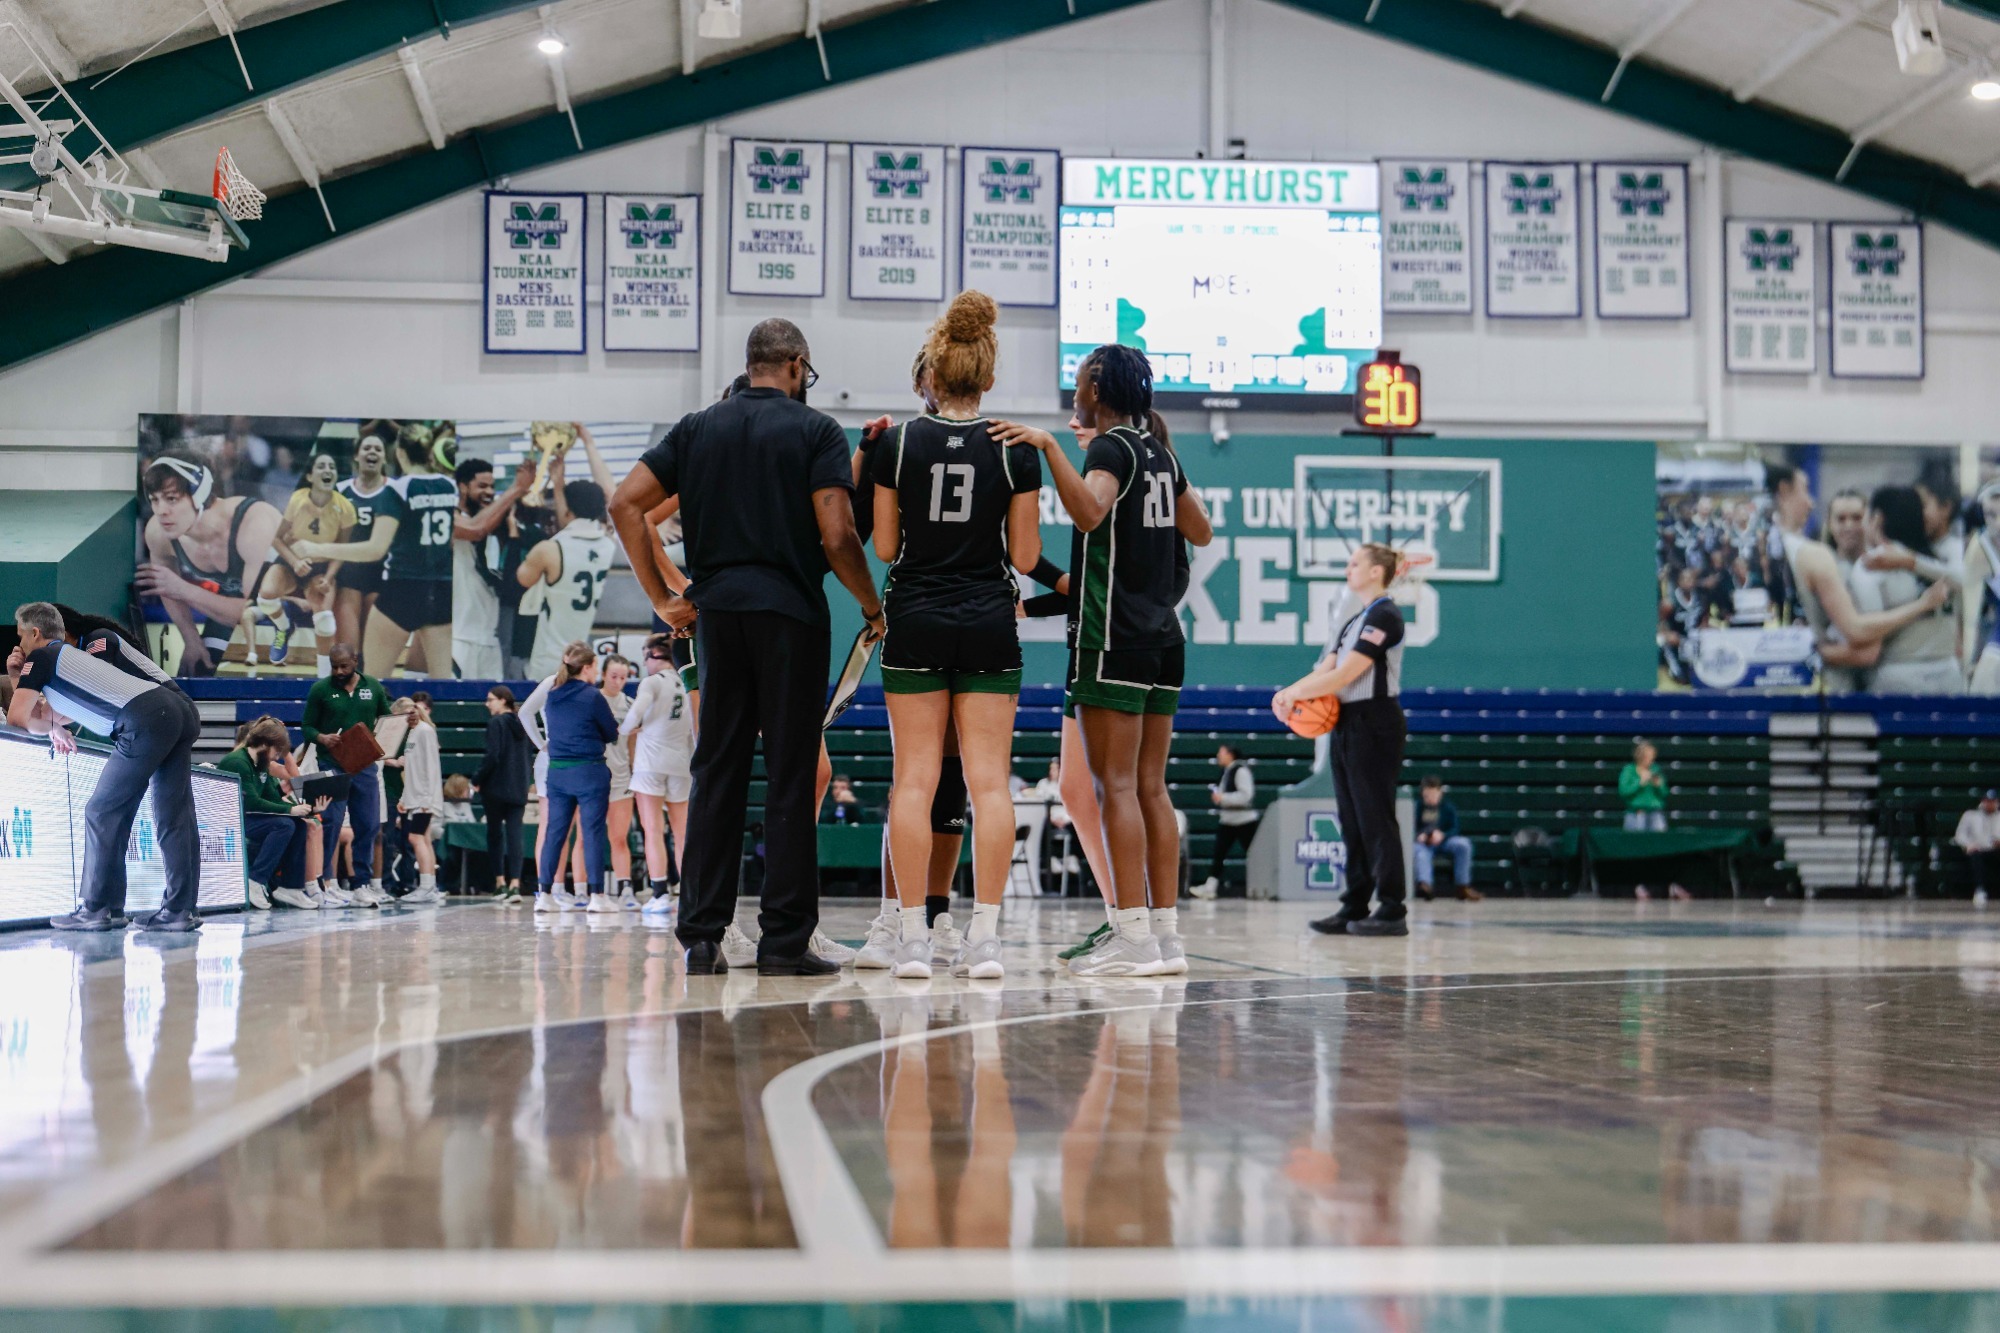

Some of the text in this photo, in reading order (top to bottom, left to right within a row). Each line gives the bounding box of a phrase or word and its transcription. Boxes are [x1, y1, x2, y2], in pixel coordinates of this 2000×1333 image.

[1094, 165, 1348, 203] MERCYHURST
[745, 202, 810, 220] ELITE 8
[866, 207, 930, 225] ELITE 8
[973, 212, 1046, 229] NATIONAL
[1389, 222, 1460, 236] NATIONAL
[965, 229, 1052, 246] CHAMPIONS
[1387, 238, 1463, 254] CHAMPION
[1491, 233, 1571, 245] TOURNAMENT
[739, 241, 815, 255] BASKETBALL
[859, 245, 935, 259] BASKETBALL
[519, 254, 552, 266] NCAA
[635, 253, 668, 265] NCAA
[1390, 261, 1462, 273] WRESTLING
[493, 267, 578, 279] TOURNAMENT
[609, 266, 693, 279] TOURNAMENT
[758, 263, 795, 280] 1996
[878, 267, 915, 284] 2019
[496, 294, 574, 306] BASKETBALL
[612, 293, 690, 306] BASKETBALL
[1365, 382, 1416, 425] 30
[929, 462, 975, 522] 13
[1143, 471, 1175, 528] 20
[358, 506, 372, 525] 5
[1241, 488, 1470, 531] UNIVERSITY
[308, 518, 320, 535] 4
[420, 510, 451, 545] 13
[671, 694, 683, 719] 2
